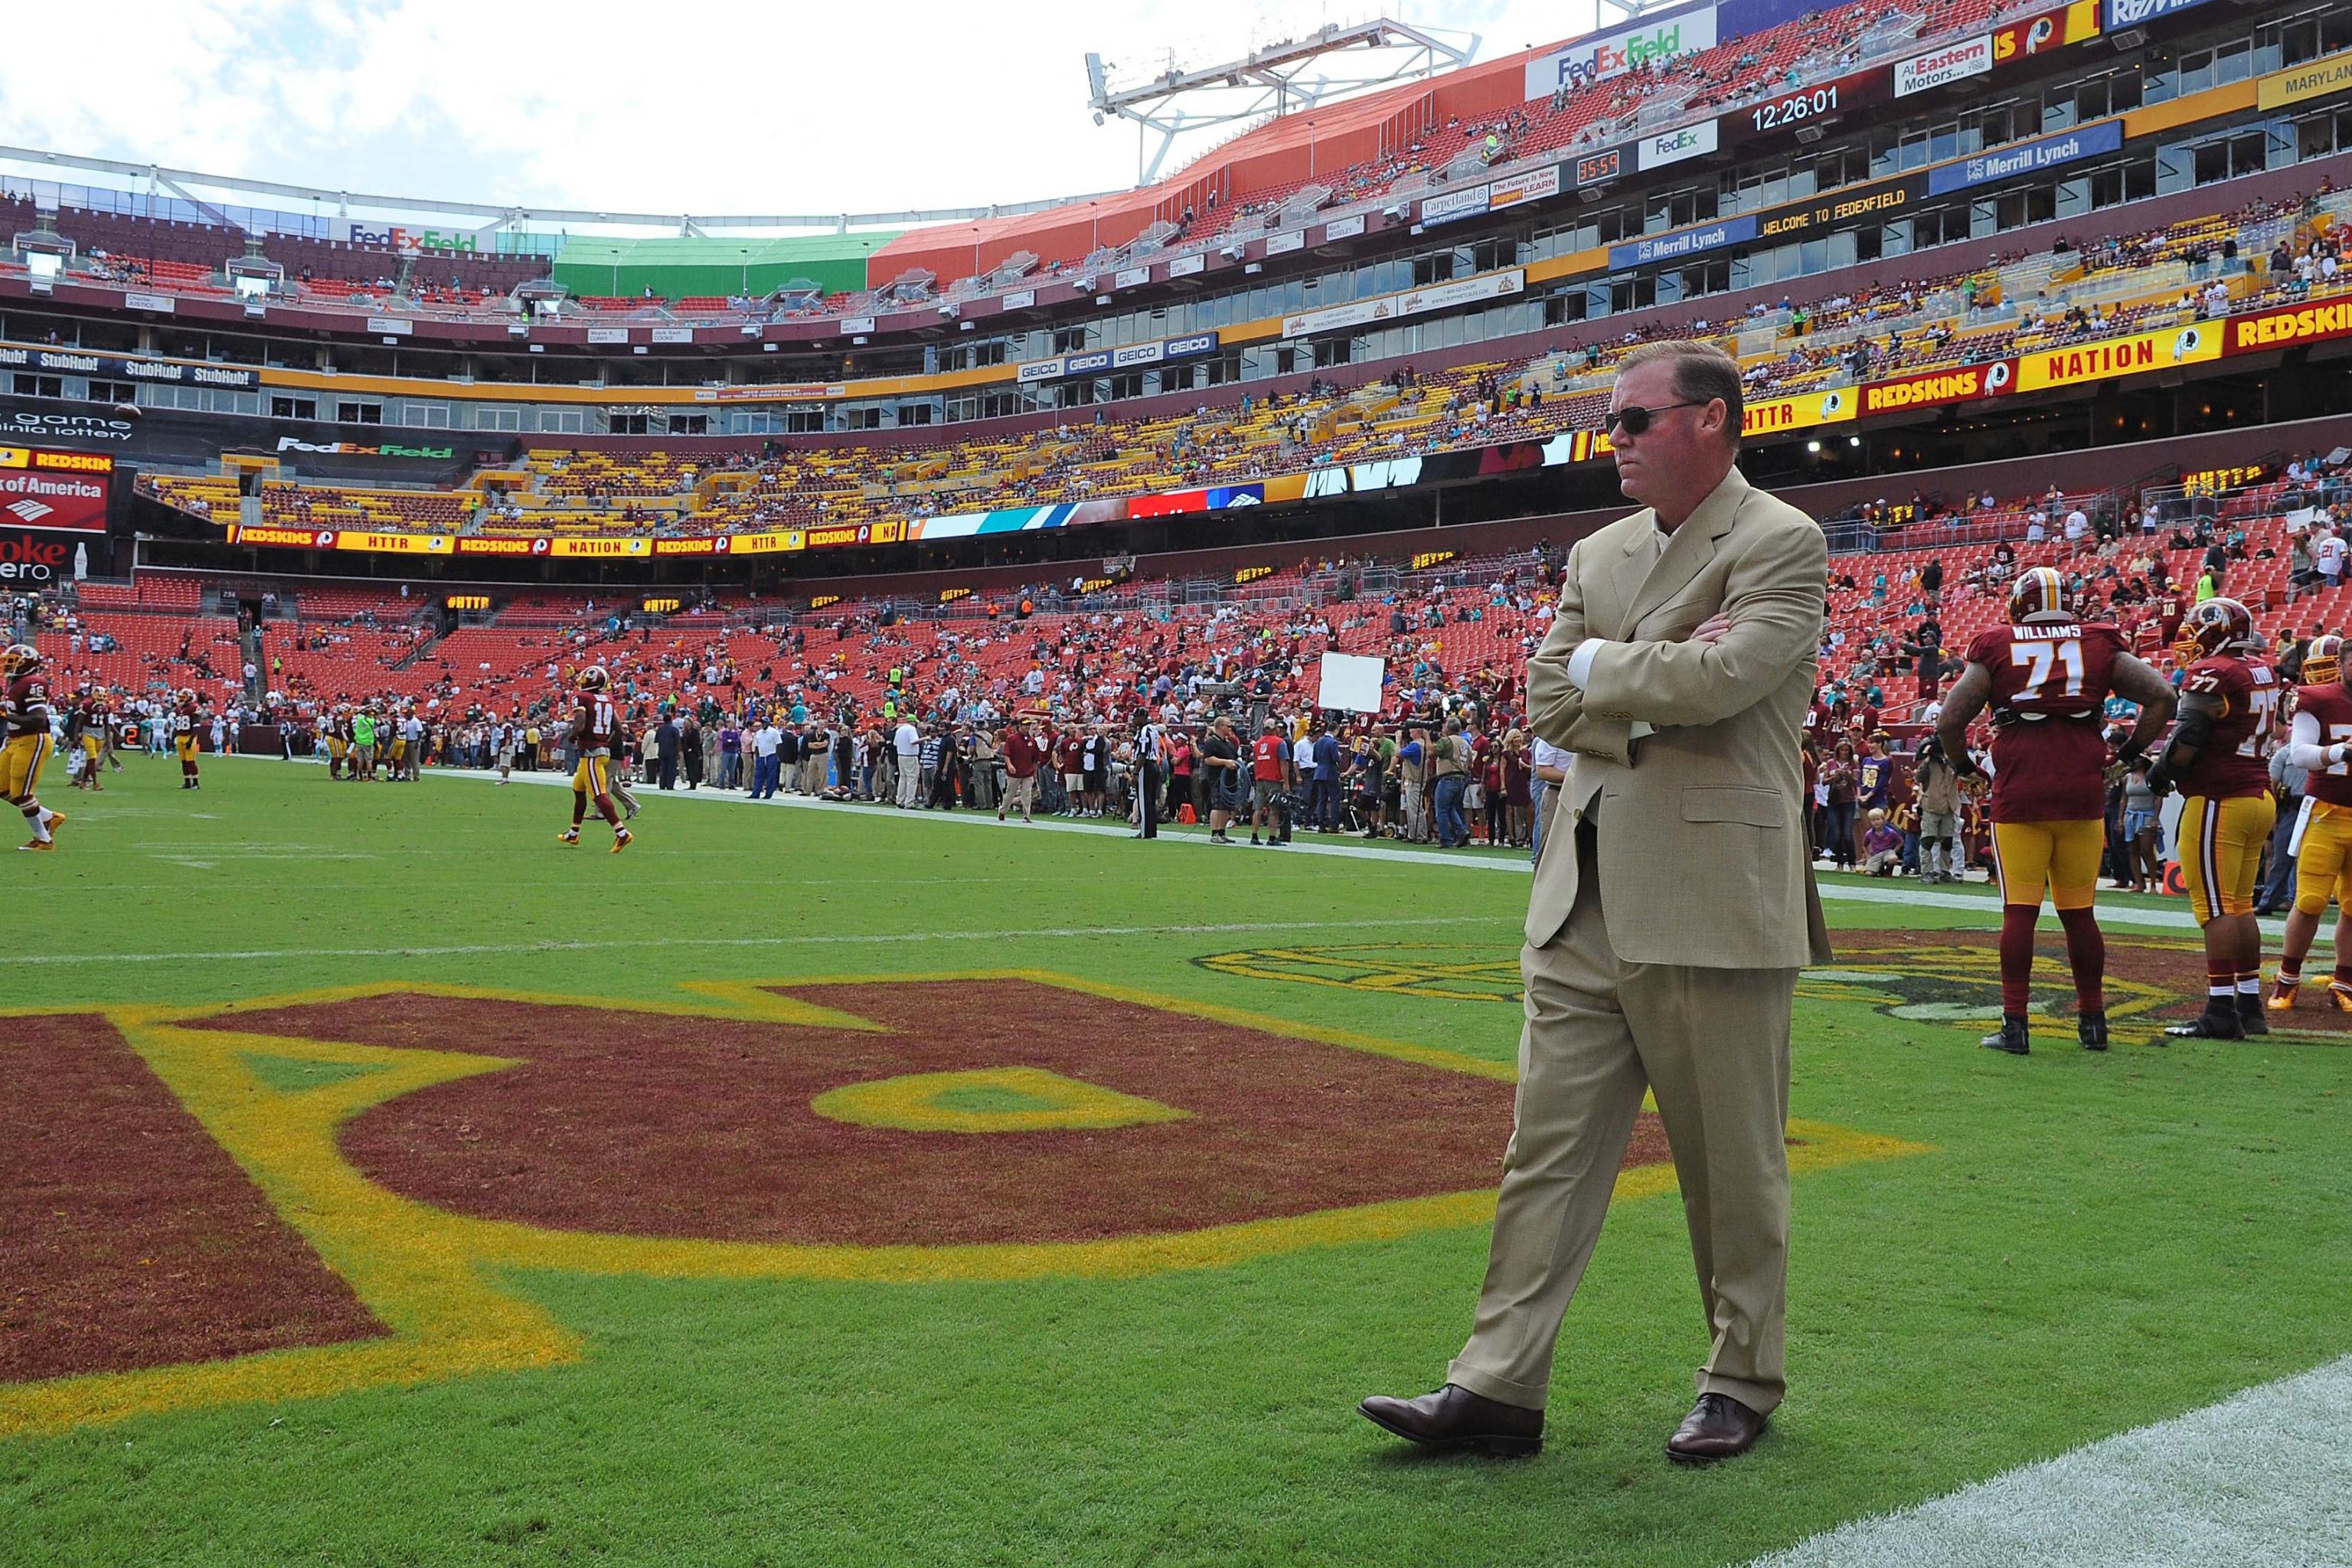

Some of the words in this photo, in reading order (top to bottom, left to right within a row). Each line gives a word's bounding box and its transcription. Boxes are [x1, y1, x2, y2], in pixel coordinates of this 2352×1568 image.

[1559, 24, 1680, 84] FedExField
[1902, 65, 1915, 77] At
[1916, 43, 1984, 75] Eastern
[1752, 86, 1837, 131] 12:26:01
[1656, 132, 1697, 155] FedEx
[1986, 149, 2033, 176] Merrill
[2037, 139, 2079, 163] Lynch
[1579, 155, 1618, 181] 35:59
[1494, 182, 1506, 191] The
[1508, 176, 1530, 188] Future
[1538, 170, 1555, 179] Now
[1524, 178, 1556, 193] LEARN
[1425, 189, 1476, 216] Carpetland
[1492, 190, 1523, 204] Support
[1423, 206, 1486, 225] www.mycarpetland.com
[1763, 214, 1808, 236] WELCOME
[1815, 209, 1829, 223] TO
[1834, 190, 1905, 219] FEDEXFIELD
[351, 224, 476, 252] FedExField
[1653, 234, 1690, 257] Merrill
[1692, 229, 1725, 251] Lynch
[1118, 347, 1155, 362] GEICO
[1168, 337, 1210, 354] GEICO
[41, 352, 98, 371] StubHub!
[126, 361, 181, 380] StubHub!
[194, 368, 249, 386] StubHub!
[1070, 354, 1107, 371] GEICO
[2050, 339, 2153, 380] NATION
[1021, 364, 1057, 379] GEICO
[1868, 372, 1978, 411] REDSKINS
[15, 413, 132, 430] game
[1743, 403, 1792, 430] HTTR
[55, 426, 132, 441] lottery
[276, 436, 453, 459] FedExField
[26, 479, 101, 498] America
[368, 535, 408, 549] HTTR
[461, 538, 529, 553] REDSKINS
[656, 539, 712, 553] REDSKINS
[752, 535, 776, 550] HTTR
[808, 529, 856, 545] REDSKINS
[569, 541, 621, 554] NATION
[2321, 545, 2334, 557] 21
[2162, 603, 2176, 616] 10
[2012, 624, 2082, 640] WILLIAMS
[2010, 639, 2086, 702] 71
[2190, 675, 2219, 693] 77
[2236, 688, 2278, 758] 77
